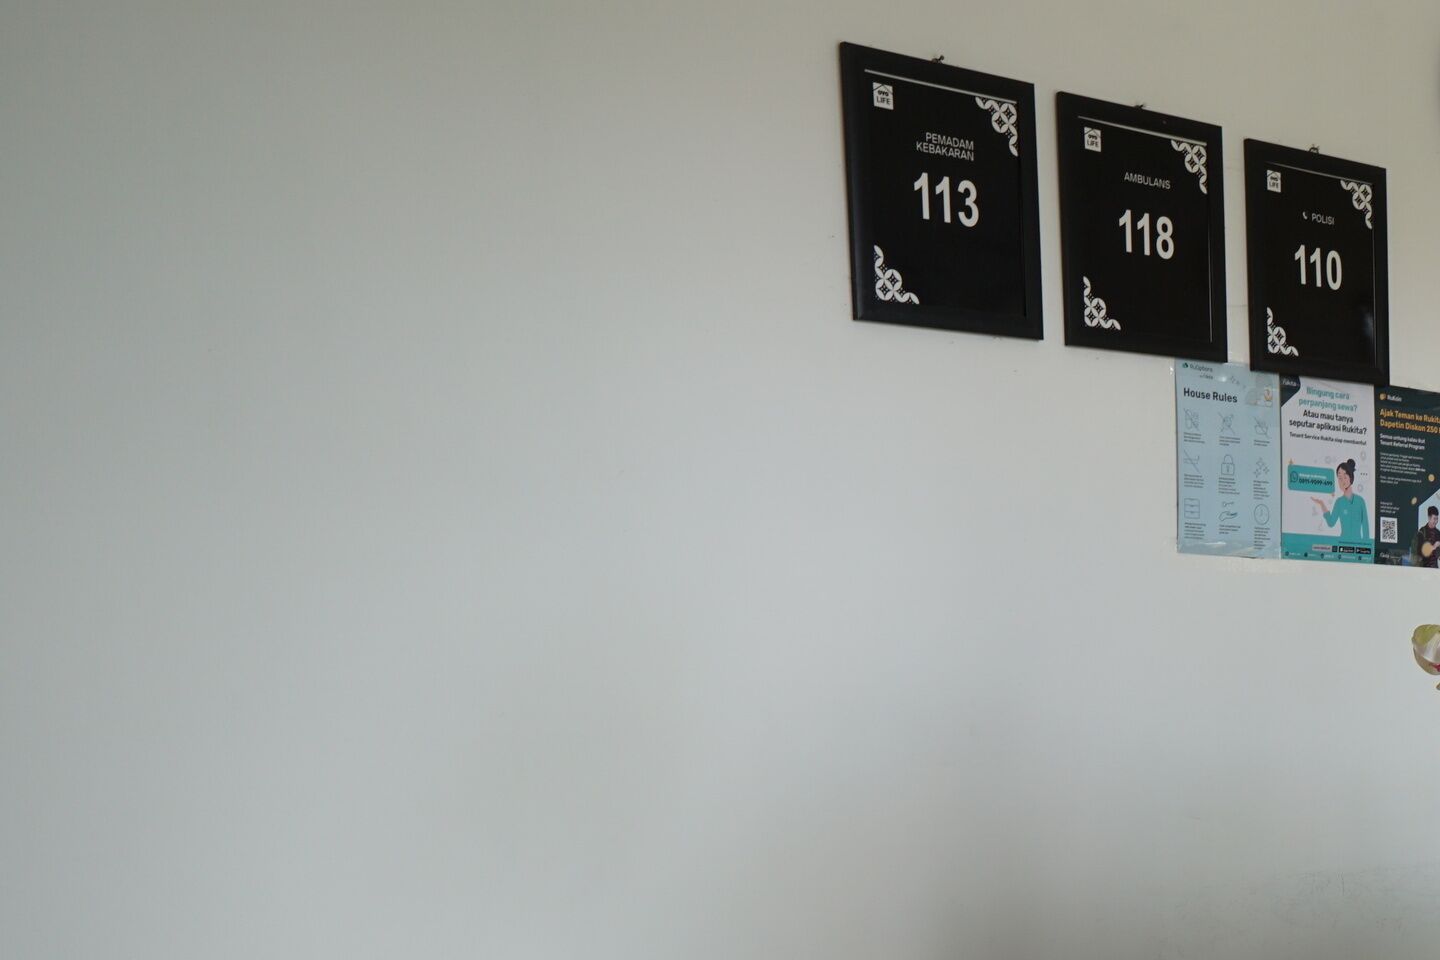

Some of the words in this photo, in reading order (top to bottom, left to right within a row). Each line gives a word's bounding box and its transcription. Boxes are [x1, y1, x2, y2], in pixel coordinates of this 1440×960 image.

[876, 96, 891, 106] LIFE
[926, 132, 974, 150] PEMADAM
[1086, 139, 1100, 148] LIFE
[916, 141, 974, 162] KEBAKARAN
[1124, 172, 1171, 190] AMBULANS
[1269, 182, 1280, 190] LIFE
[914, 172, 980, 228] 113
[1312, 212, 1334, 226] POLISI
[1118, 209, 1174, 260] 118
[1294, 244, 1342, 291] 110
[1184, 388, 1210, 400] House
[1212, 392, 1238, 402] Rules
[1306, 387, 1334, 399] Bingung
[1298, 398, 1336, 410] perpanjang
[1338, 404, 1358, 412] sewa?
[1303, 410, 1319, 418] Atau
[1336, 414, 1354, 424] tanya
[1380, 408, 1394, 418] Ajak
[1394, 410, 1414, 420] Teman
[1416, 413, 1422, 421] ke
[1289, 420, 1314, 428] seputar
[1316, 422, 1341, 432] aplikasi
[1342, 425, 1367, 434] Rukita?
[1380, 419, 1404, 429] Dapetin
[1406, 422, 1426, 432] Diskon
[1426, 425, 1438, 433] 250
